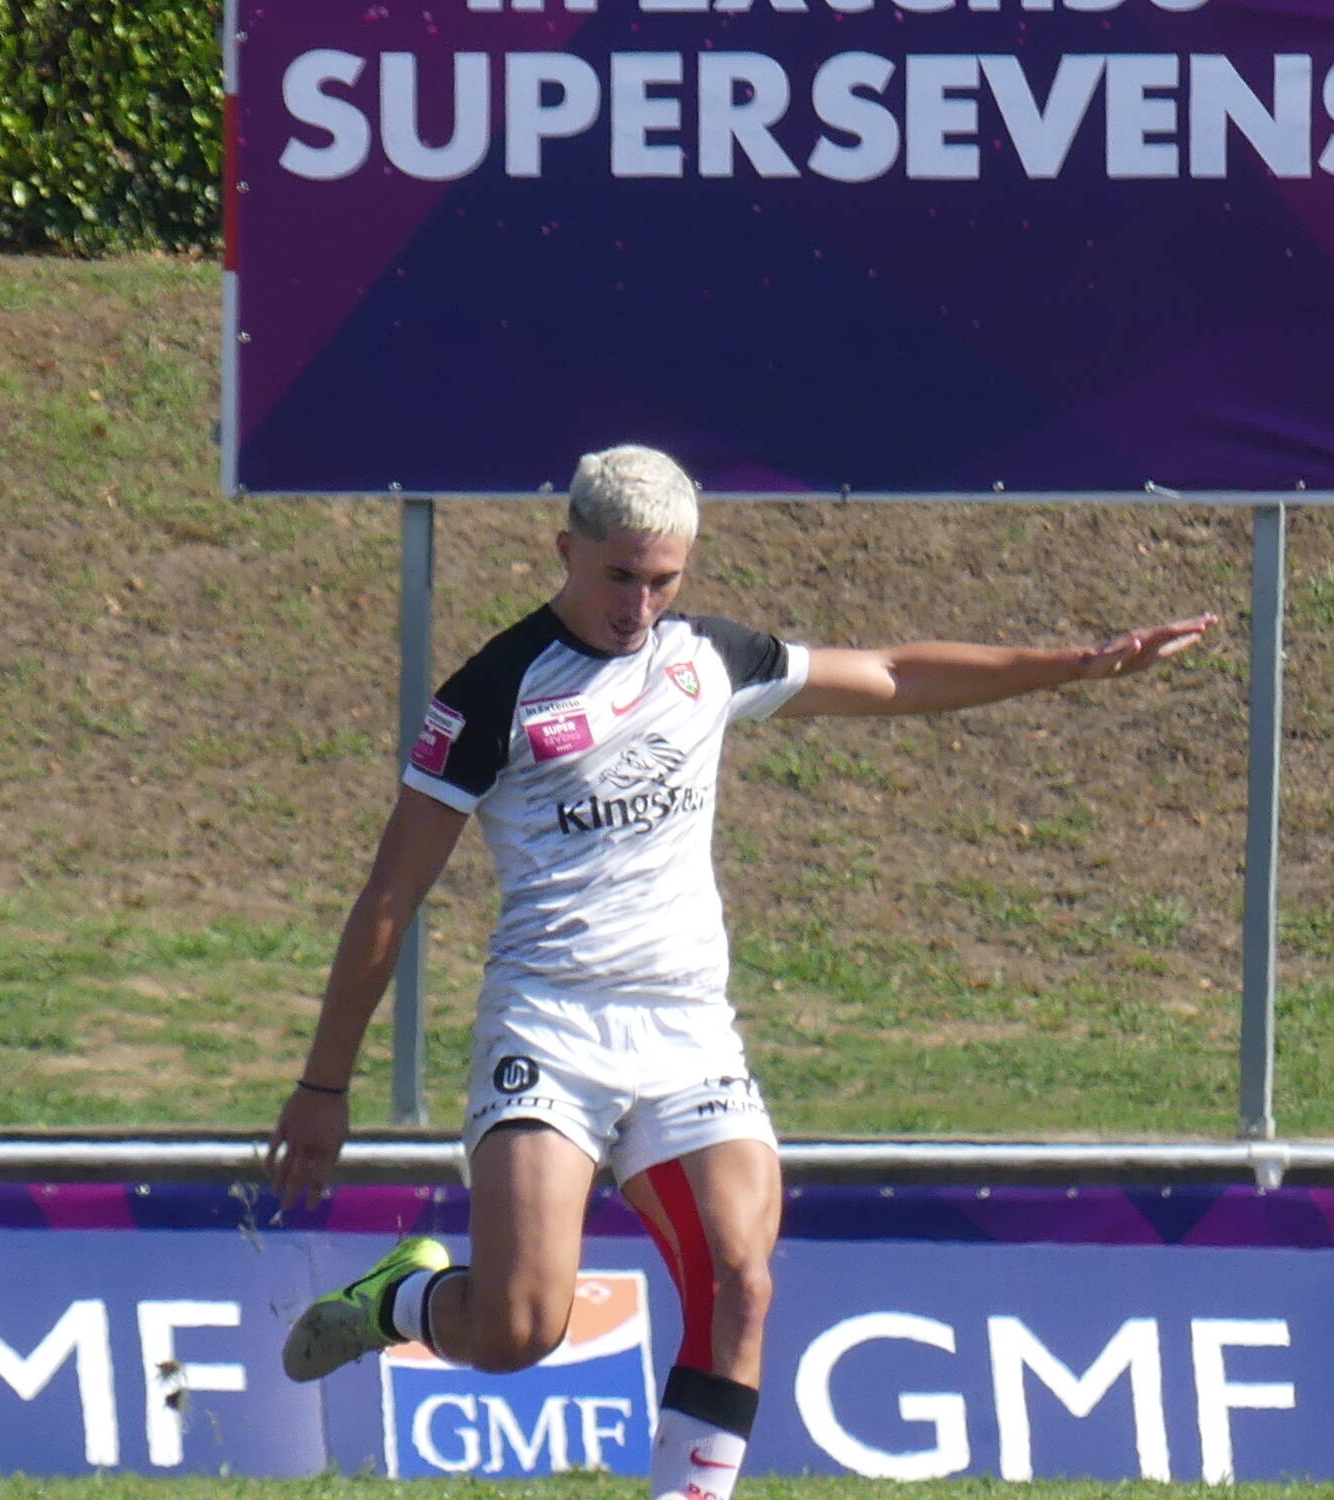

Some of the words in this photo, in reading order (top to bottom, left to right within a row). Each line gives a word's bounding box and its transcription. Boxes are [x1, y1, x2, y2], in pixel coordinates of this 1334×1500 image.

[542, 721, 575, 736] SUPER
[411, 1393, 633, 1473] GMF
[795, 1313, 1295, 1487] GMF
